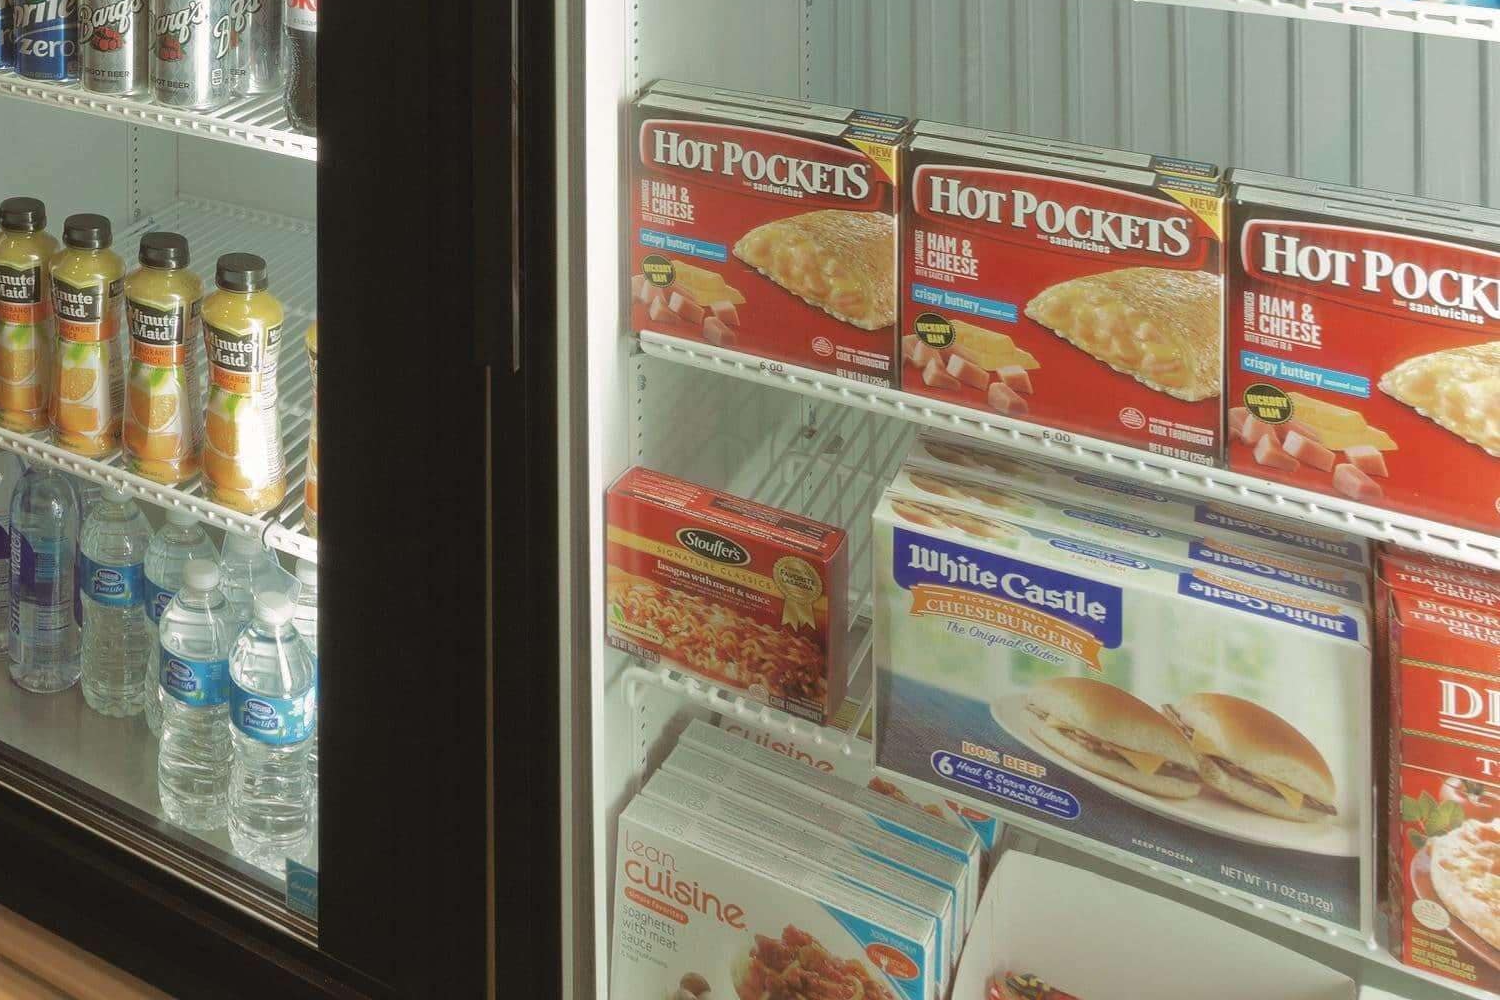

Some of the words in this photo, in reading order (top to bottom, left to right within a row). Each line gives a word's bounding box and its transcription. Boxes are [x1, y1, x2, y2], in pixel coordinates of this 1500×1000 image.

[652, 181, 677, 201] HAM
[680, 187, 690, 204] &
[753, 182, 804, 199] sandwiches
[651, 198, 695, 221] CHEESE
[926, 232, 957, 255] HAM
[962, 239, 973, 258] &
[1049, 235, 1111, 255] sandwiches
[926, 250, 979, 277] CHEESE
[914, 288, 944, 305] crispy
[944, 292, 980, 313] buttery
[1259, 293, 1295, 320] HAM
[1302, 302, 1315, 325] &
[1409, 300, 1485, 325] sandwiches
[1259, 313, 1322, 346] CHEESE
[759, 361, 784, 373] 6.00
[1244, 354, 1277, 376] crispy
[1280, 361, 1323, 386] buttery
[1042, 431, 1071, 444] 6.00
[685, 530, 741, 562] Stouffer's
[691, 572, 712, 586] with
[712, 579, 736, 594] meat
[908, 543, 998, 590] White
[1001, 573, 1107, 624] Castle
[926, 599, 1085, 656] CHEESEBURGERS
[946, 620, 966, 635] The
[969, 625, 1021, 649] Original
[938, 756, 954, 775] 6
[983, 769, 994, 780] &
[962, 740, 1001, 765] 100%
[1003, 753, 1047, 779] BEEF
[625, 828, 678, 873] lean
[624, 859, 747, 931] cuisine
[622, 904, 675, 937] spaghetti
[621, 933, 653, 953] sauce
[622, 919, 647, 936] with
[649, 930, 679, 952] meat
